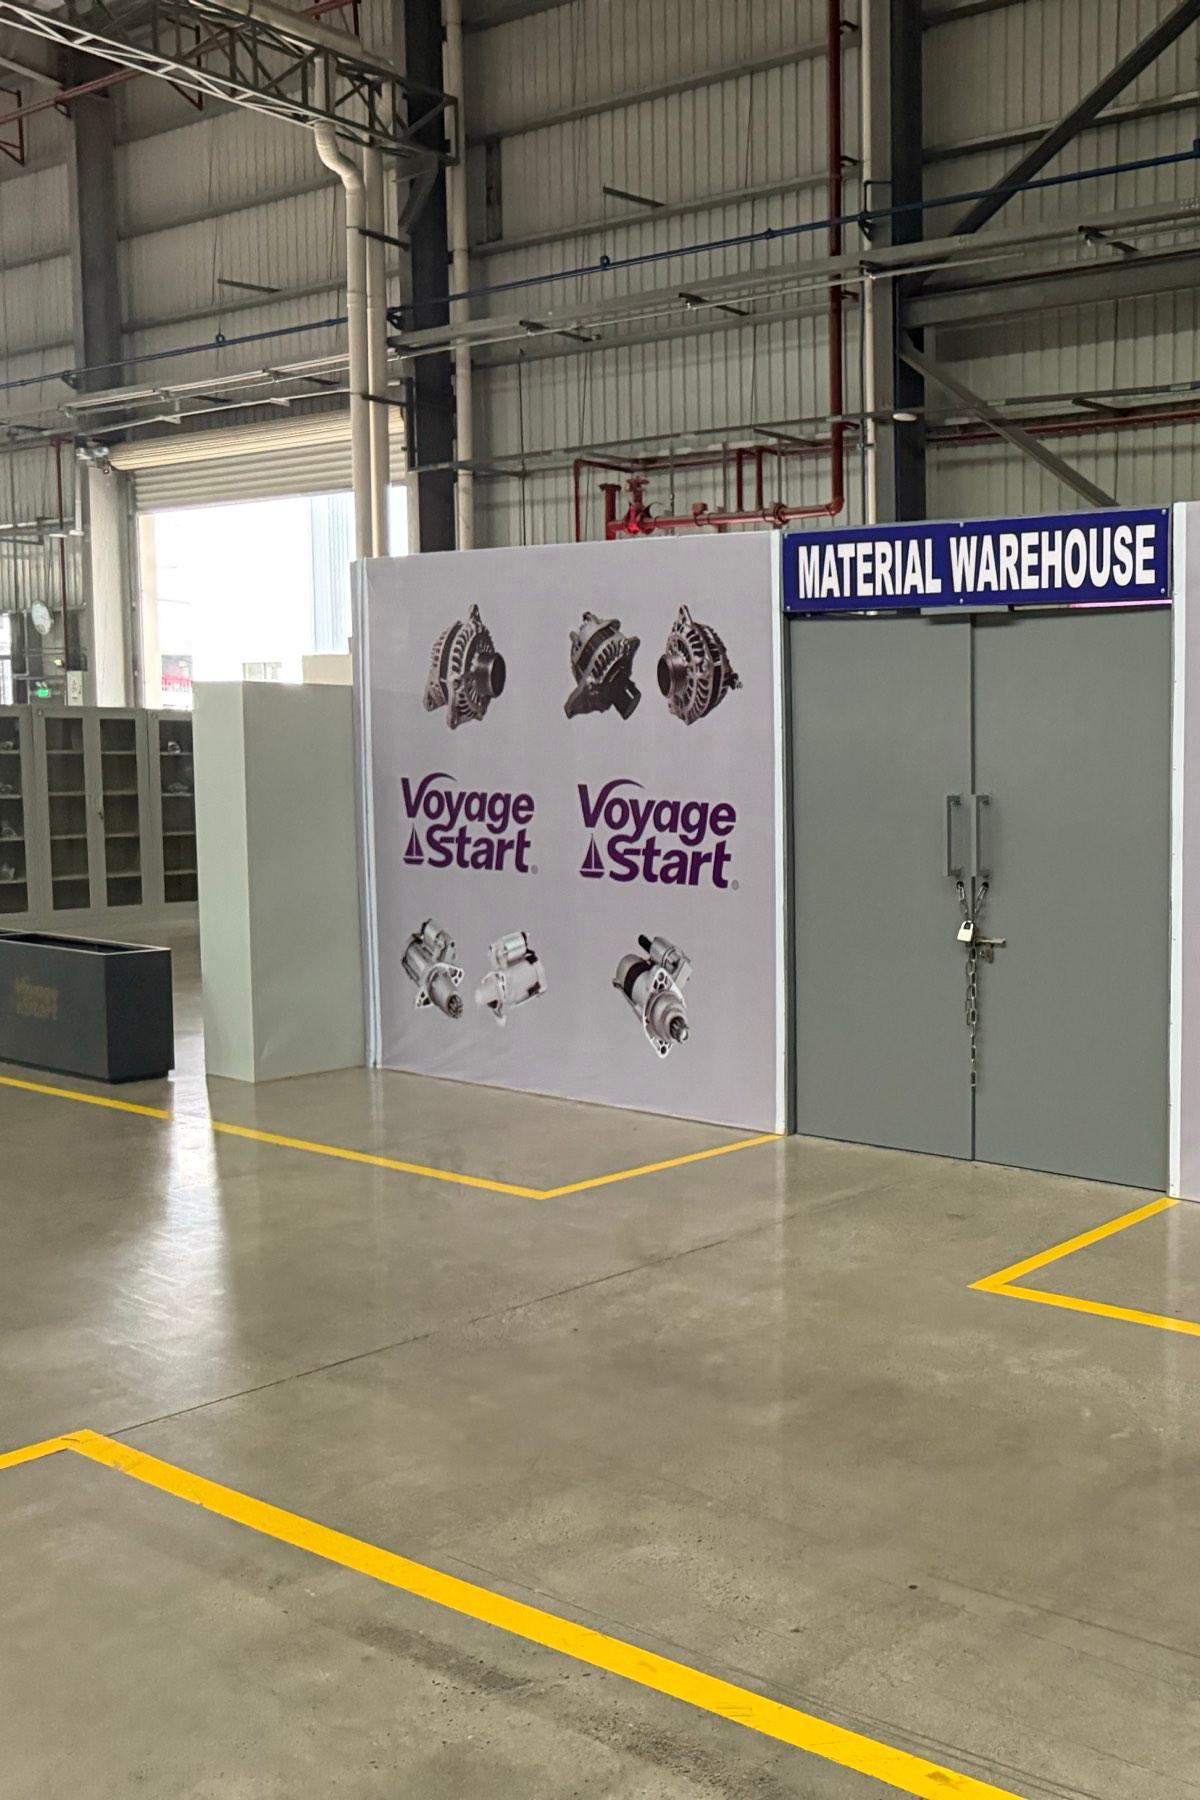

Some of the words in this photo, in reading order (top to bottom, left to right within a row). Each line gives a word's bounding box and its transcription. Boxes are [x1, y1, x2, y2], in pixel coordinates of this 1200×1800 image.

[798, 538, 942, 599] MATERIAL
[949, 524, 1156, 593] WAREHOUSE
[401, 772, 535, 834] Voyage
[577, 779, 736, 846] Voyage
[426, 824, 532, 873] Start
[606, 834, 732, 888] Start
